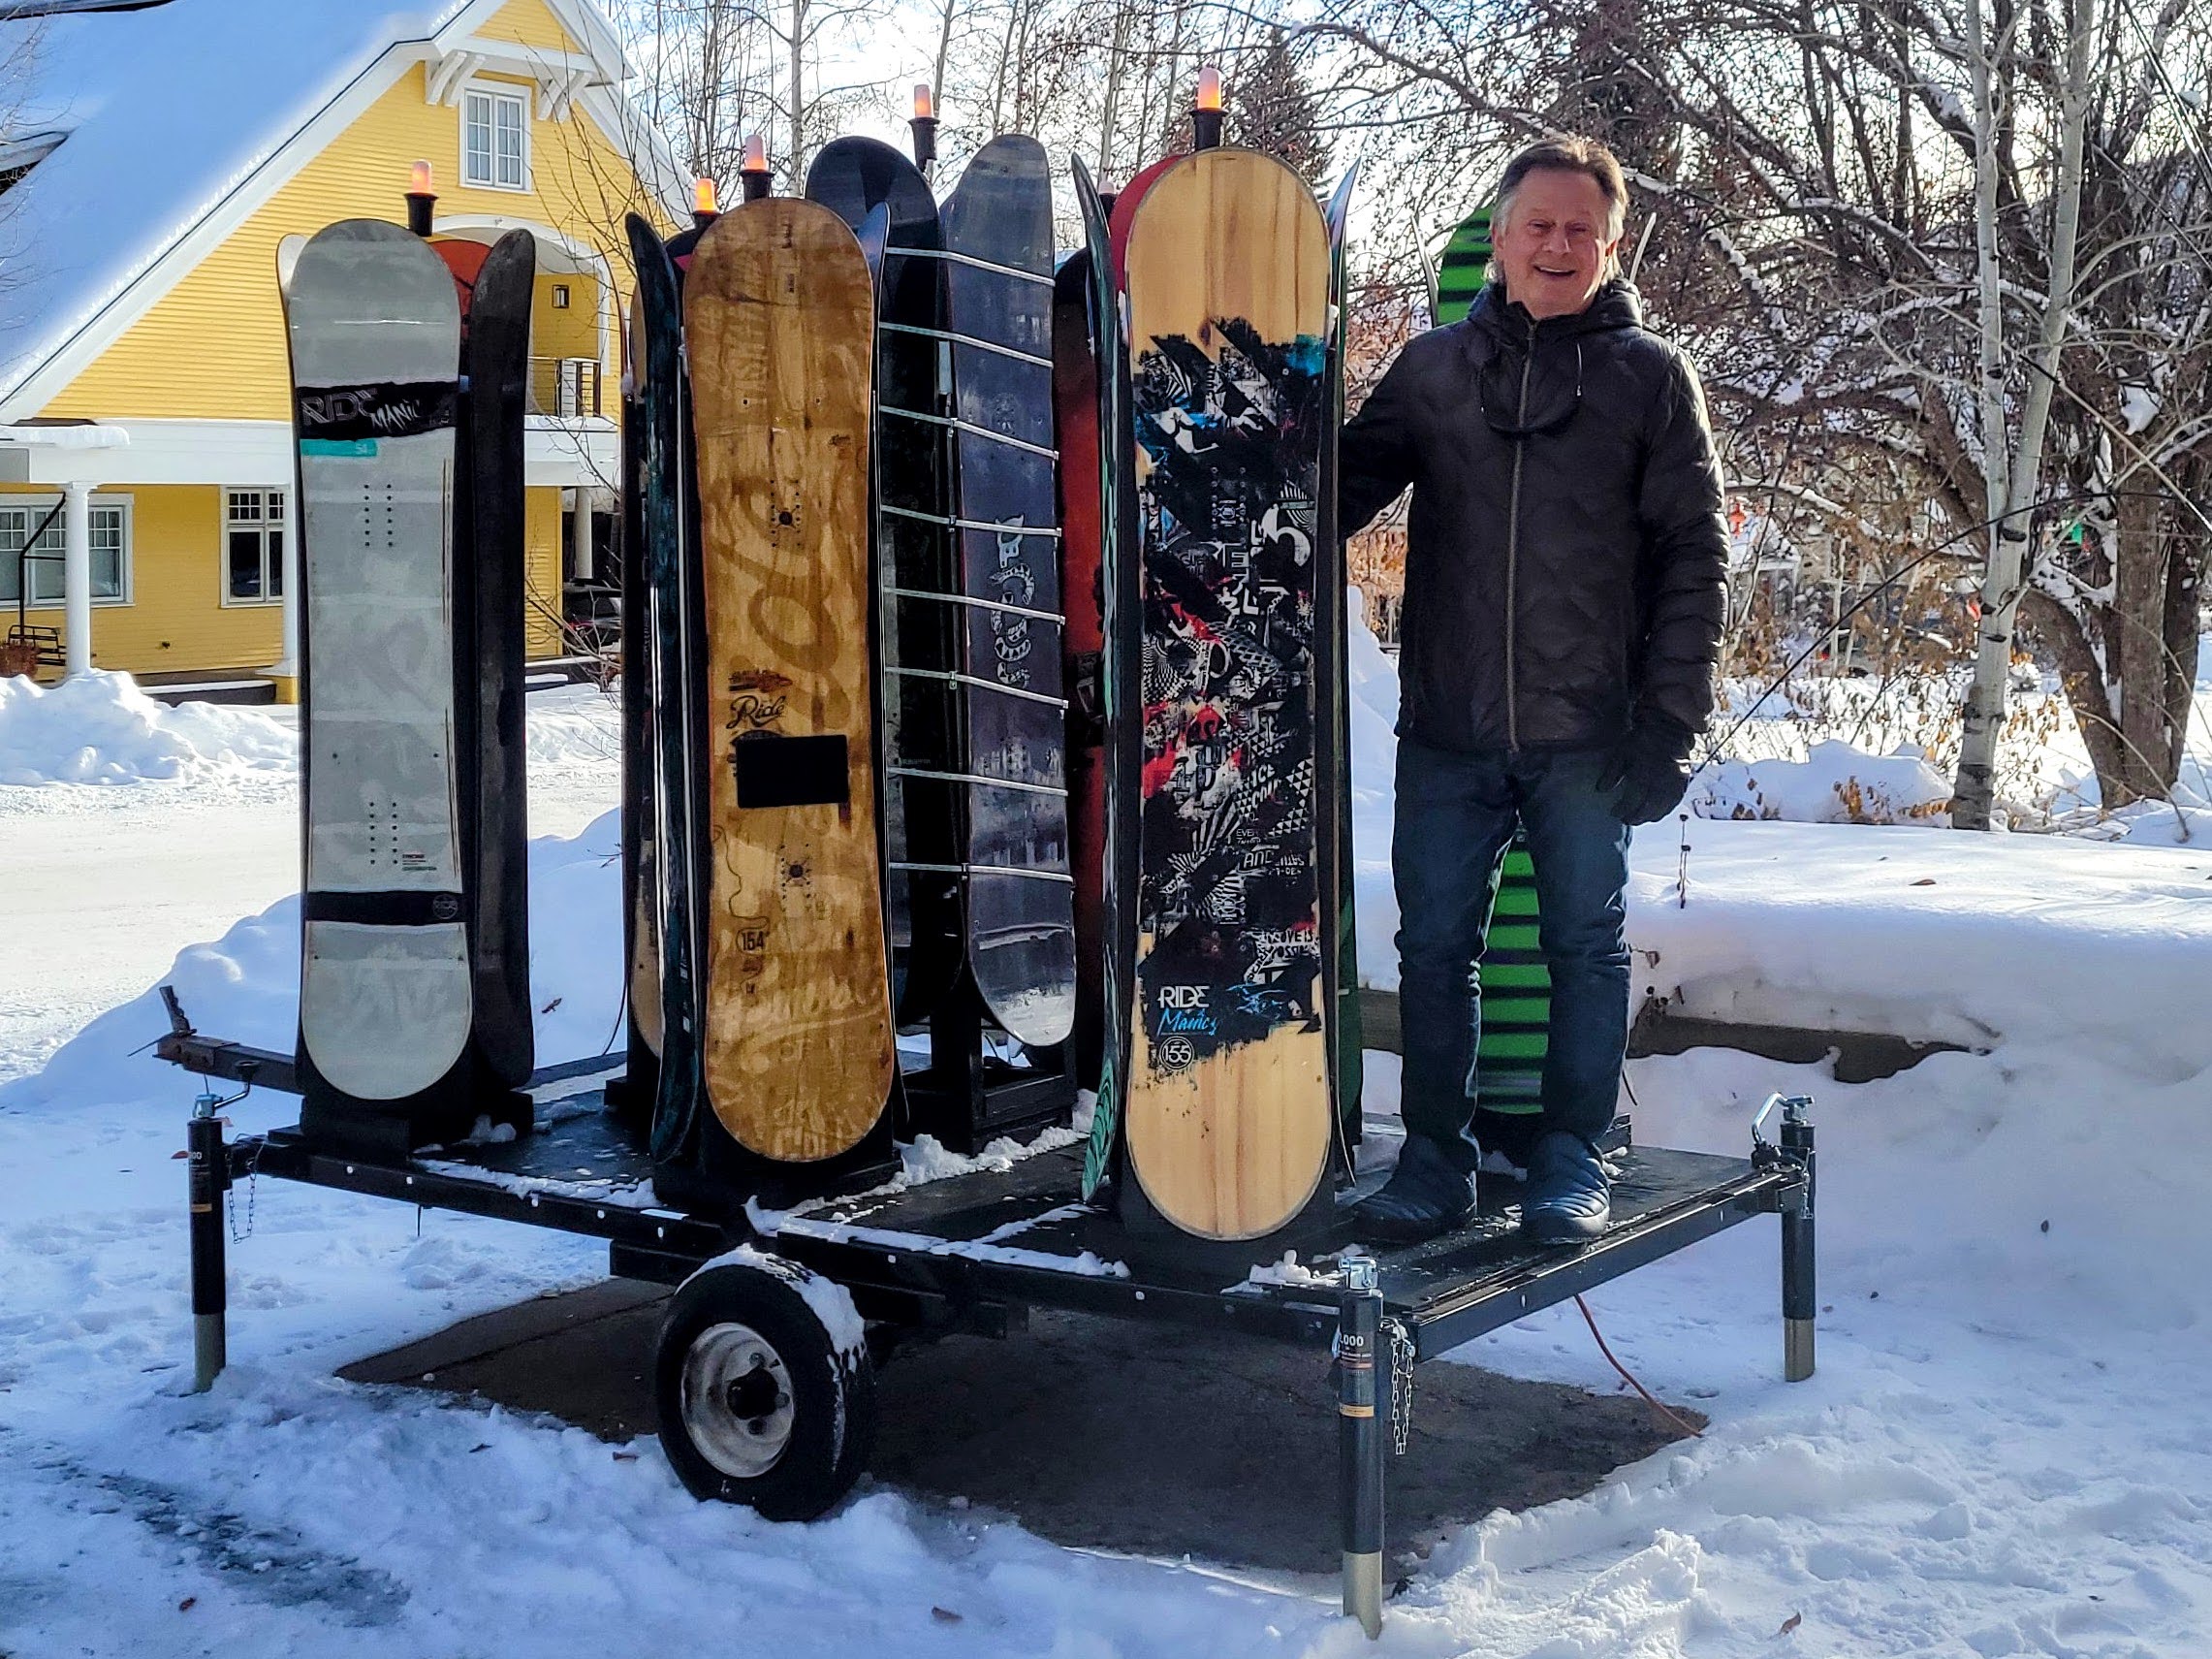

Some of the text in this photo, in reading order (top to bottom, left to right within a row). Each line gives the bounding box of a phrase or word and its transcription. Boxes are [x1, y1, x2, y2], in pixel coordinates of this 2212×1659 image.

[726, 694, 787, 729] Ride
[742, 931, 764, 951] 154
[1157, 985, 1211, 1008] RIDE
[1163, 1044, 1192, 1064] 155
